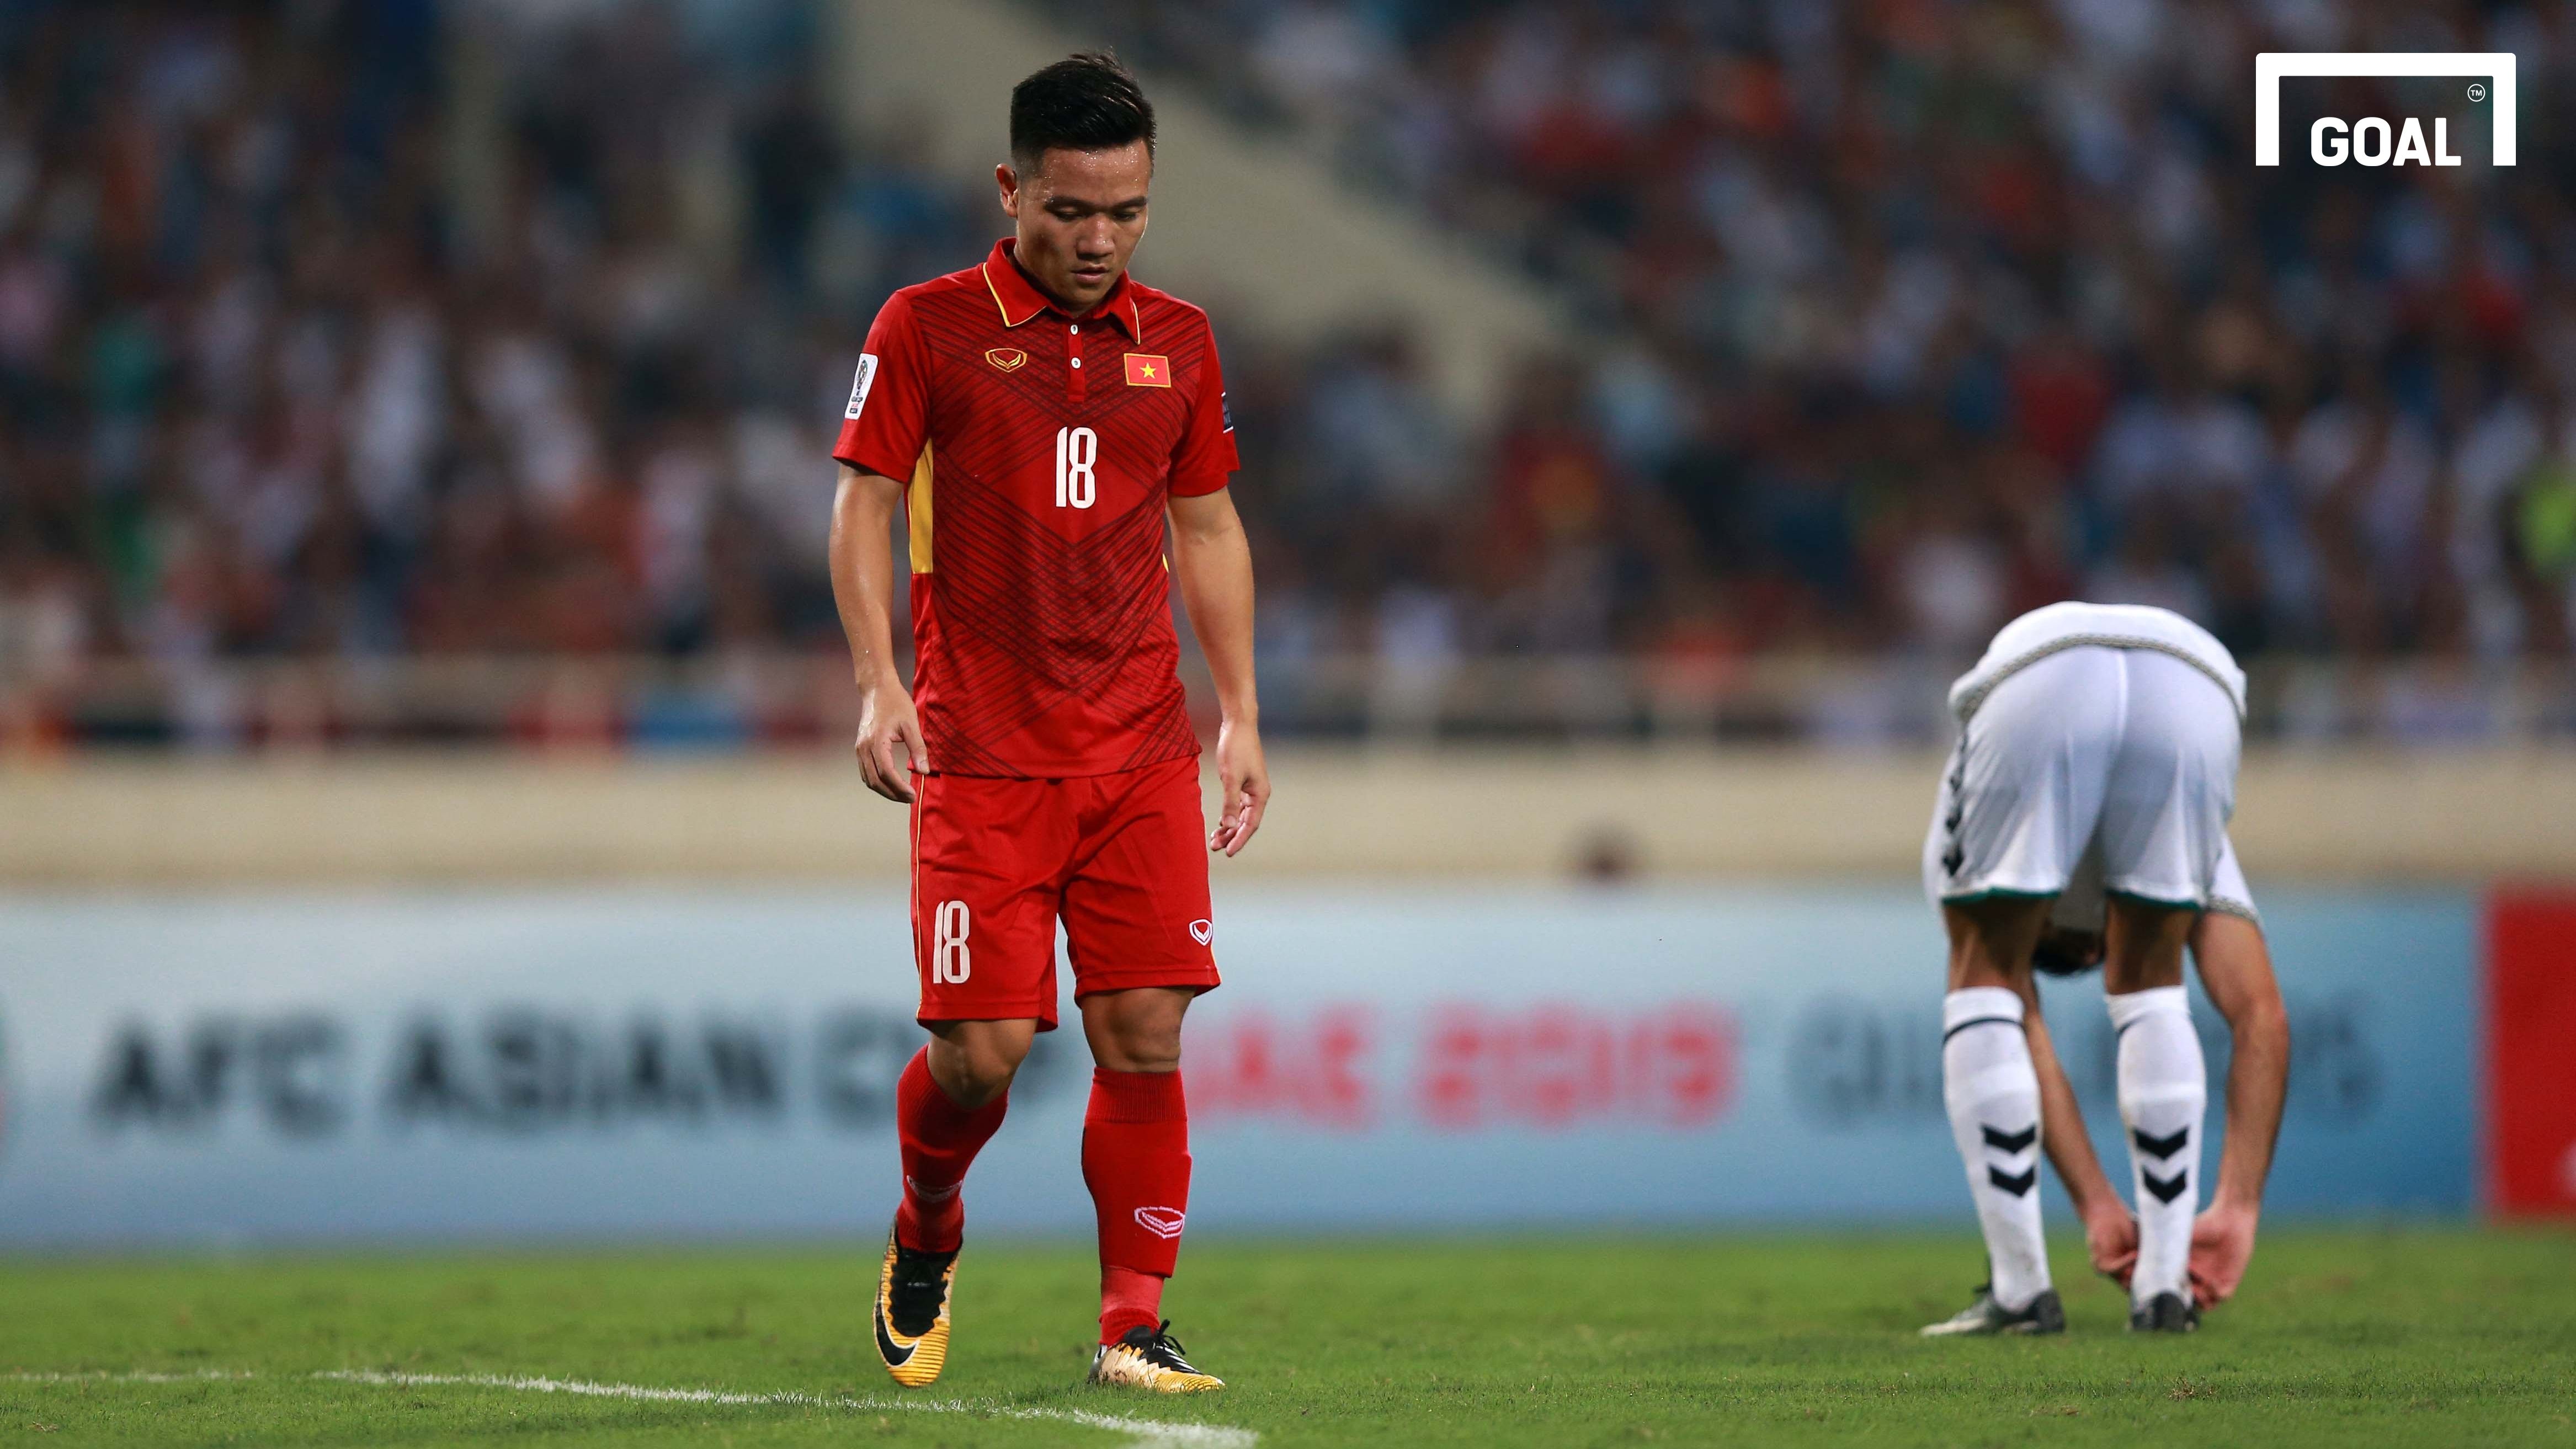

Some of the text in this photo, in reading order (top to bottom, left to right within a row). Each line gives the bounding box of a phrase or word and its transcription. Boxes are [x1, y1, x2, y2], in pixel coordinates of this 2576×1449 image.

[1056, 427, 1098, 509] 18
[933, 900, 971, 984] 18
[93, 1011, 348, 1132] AFC
[384, 1009, 784, 1132] ASIAN
[1419, 999, 1737, 1136] 2019
